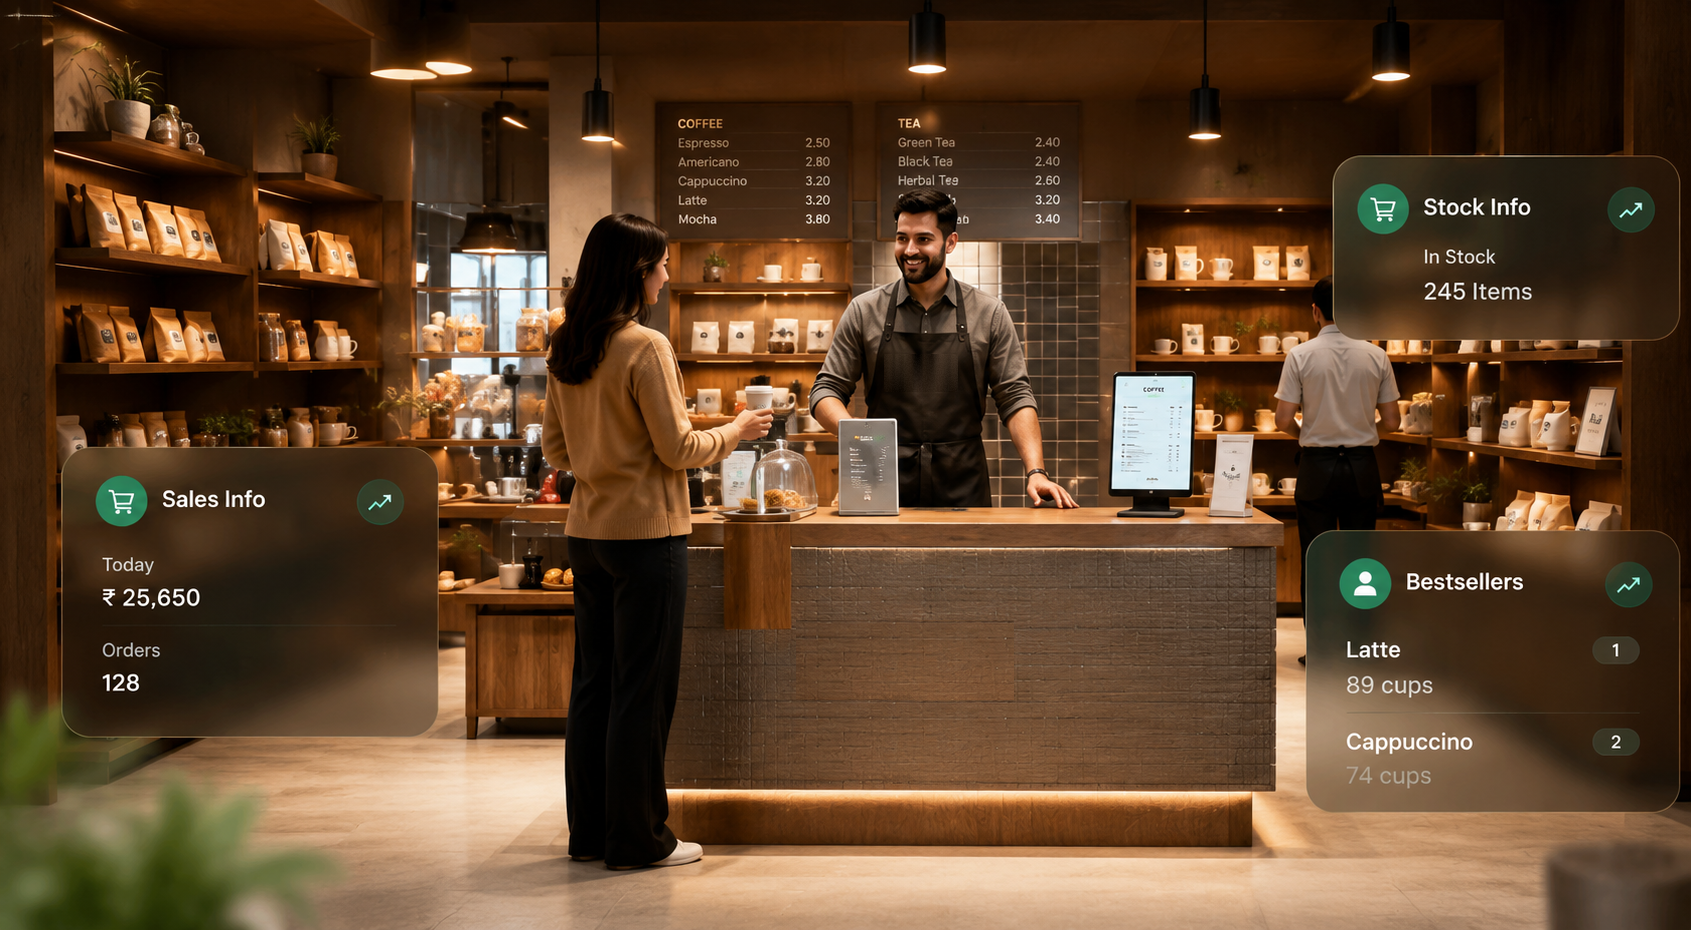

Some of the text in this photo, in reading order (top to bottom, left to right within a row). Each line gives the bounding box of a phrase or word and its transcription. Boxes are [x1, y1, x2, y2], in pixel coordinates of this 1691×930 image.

[677, 118, 723, 129] COFFEE
[897, 117, 922, 129] TEA
[678, 137, 831, 151] Espresso 2.50
[897, 136, 1061, 148] Green Tea 2.40
[677, 156, 831, 168] Americano 2.80
[898, 155, 1061, 167] Black Tea 2.40
[678, 175, 831, 189] Cappuccino 3.20
[898, 174, 935, 186] Herbal
[1035, 174, 1061, 186] 2.60
[678, 194, 831, 206] Latte 3.20
[1035, 194, 1061, 206] 3.20
[678, 213, 831, 225] Mocha 3.80
[1035, 213, 1061, 225] 3.40
